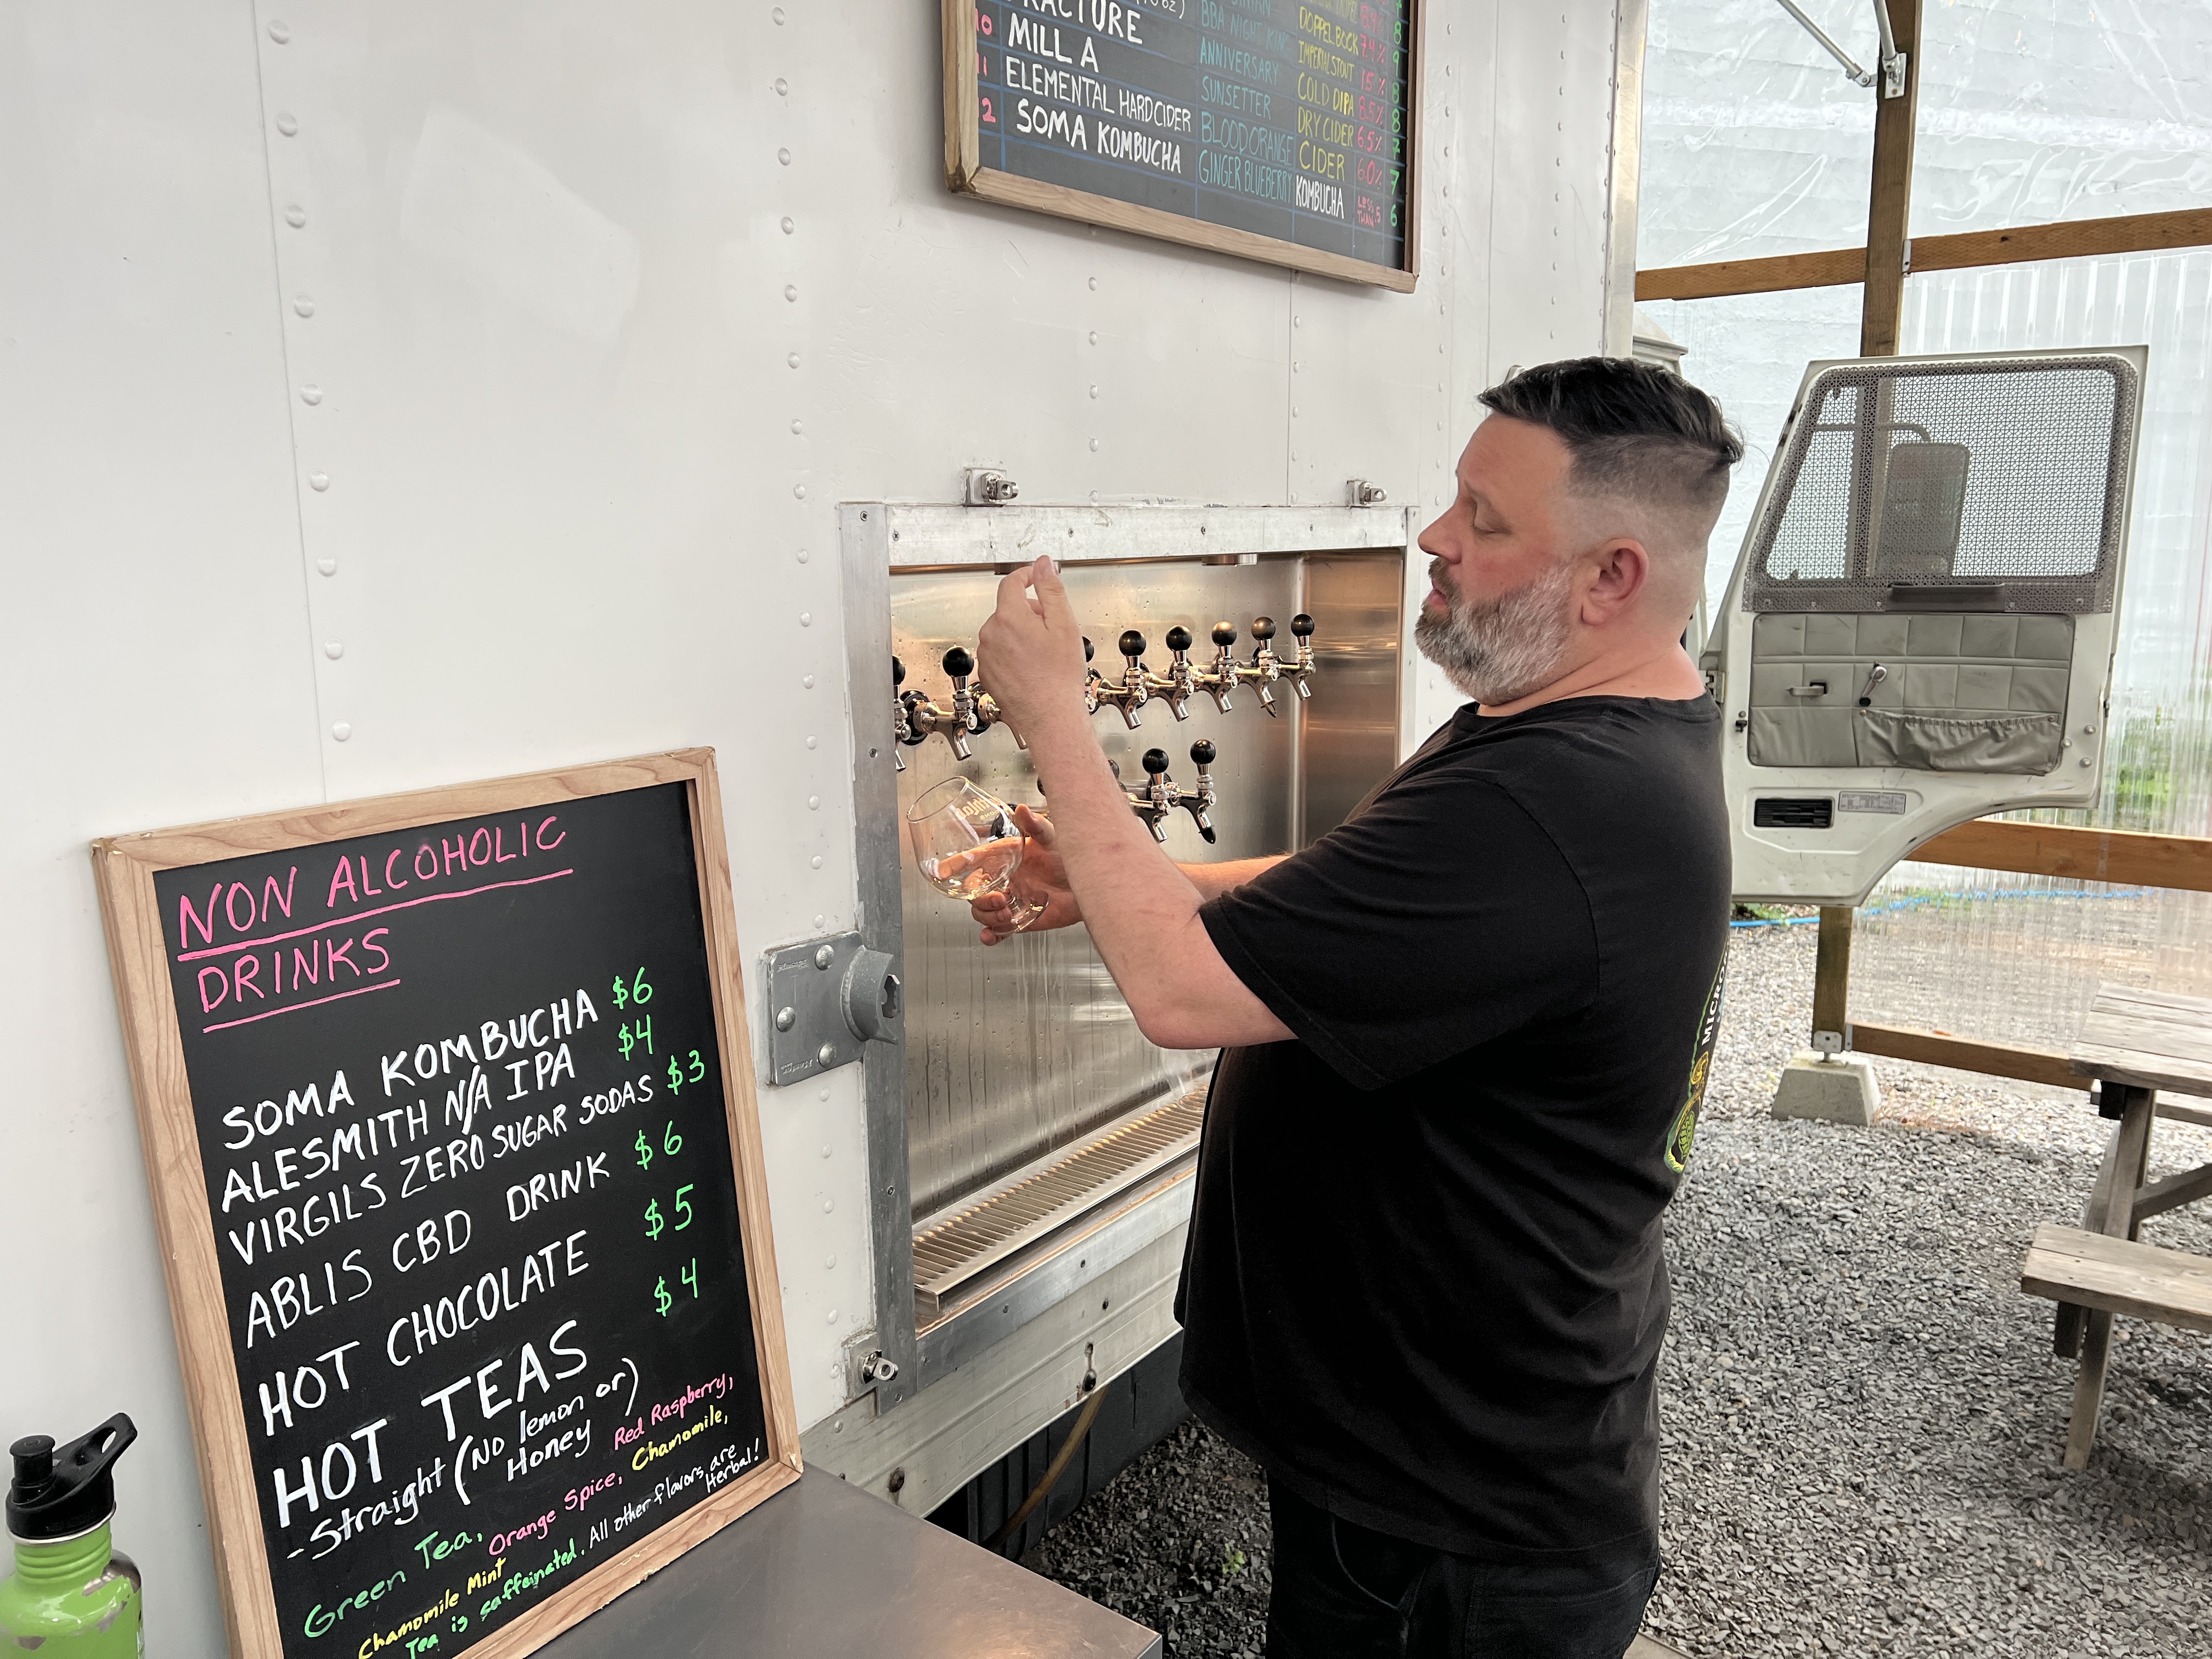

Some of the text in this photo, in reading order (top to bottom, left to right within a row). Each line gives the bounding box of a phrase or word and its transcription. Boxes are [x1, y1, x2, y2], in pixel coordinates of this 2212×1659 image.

[1008, 12, 1073, 64] MILL
[1080, 36, 1099, 72] A
[1201, 75, 1271, 120] SUNSETTER
[1297, 106, 1322, 138] DRY
[1323, 114, 1354, 147] CIDER
[1392, 138, 1401, 160] 7
[1200, 36, 1279, 86] ANNIVERSARY
[1297, 72, 1330, 107] COLD
[1333, 88, 1355, 117] DIPA
[1392, 108, 1400, 133] 8
[1201, 0, 1224, 31] BBA
[1230, 13, 1262, 46] NIGHT
[1330, 55, 1355, 82] STOUT
[1392, 81, 1400, 104] 8
[1393, 21, 1401, 44] 8
[1393, 50, 1400, 77] 9
[1006, 55, 1115, 114] ELEMENTAL
[1299, 140, 1346, 182] CIDER
[1390, 169, 1400, 195] 7
[1016, 98, 1087, 151] SOMA
[1097, 121, 1182, 174] KOMBUCHA
[1199, 149, 1242, 192] GINGER
[1244, 160, 1294, 204] BLUEBERRY
[1295, 174, 1345, 219] KOMBUCHA
[1357, 195, 1374, 213] LESS
[1390, 204, 1397, 227] 6
[180, 816, 566, 949] NON ALCOHOLIC
[198, 928, 389, 1013] DRINKS
[222, 1014, 653, 1213] ALESMITH N/A IPA $4
[223, 967, 652, 1149] SOMA KOMBUCHA $6
[229, 1050, 704, 1265] VIRGILS ZERO SUGAR SODAS $3
[247, 1249, 372, 1348] ABLIS
[393, 1210, 471, 1272] CBD
[506, 1152, 609, 1222] DRINK
[259, 1341, 360, 1436] HOT
[387, 1230, 589, 1366] CHOCOLATE
[273, 1419, 387, 1528] HOT
[421, 1320, 586, 1441] TEAS
[507, 1419, 590, 1481] Honey
[521, 1396, 584, 1443] lemon
[596, 1358, 638, 1416] or)
[615, 1374, 732, 1450] Red Raspberry,
[706, 1437, 760, 1493] Herbal!
[304, 1405, 728, 1637] Green Tea, Orange Spice, Chamomile,
[405, 1634, 438, 1659] Tea
[452, 1616, 467, 1632] is
[590, 1518, 608, 1549] All
[614, 1499, 651, 1531] other
[654, 1466, 703, 1504] flavors
[710, 1444, 737, 1470] are
[359, 1558, 506, 1659] Chamomile Mint
